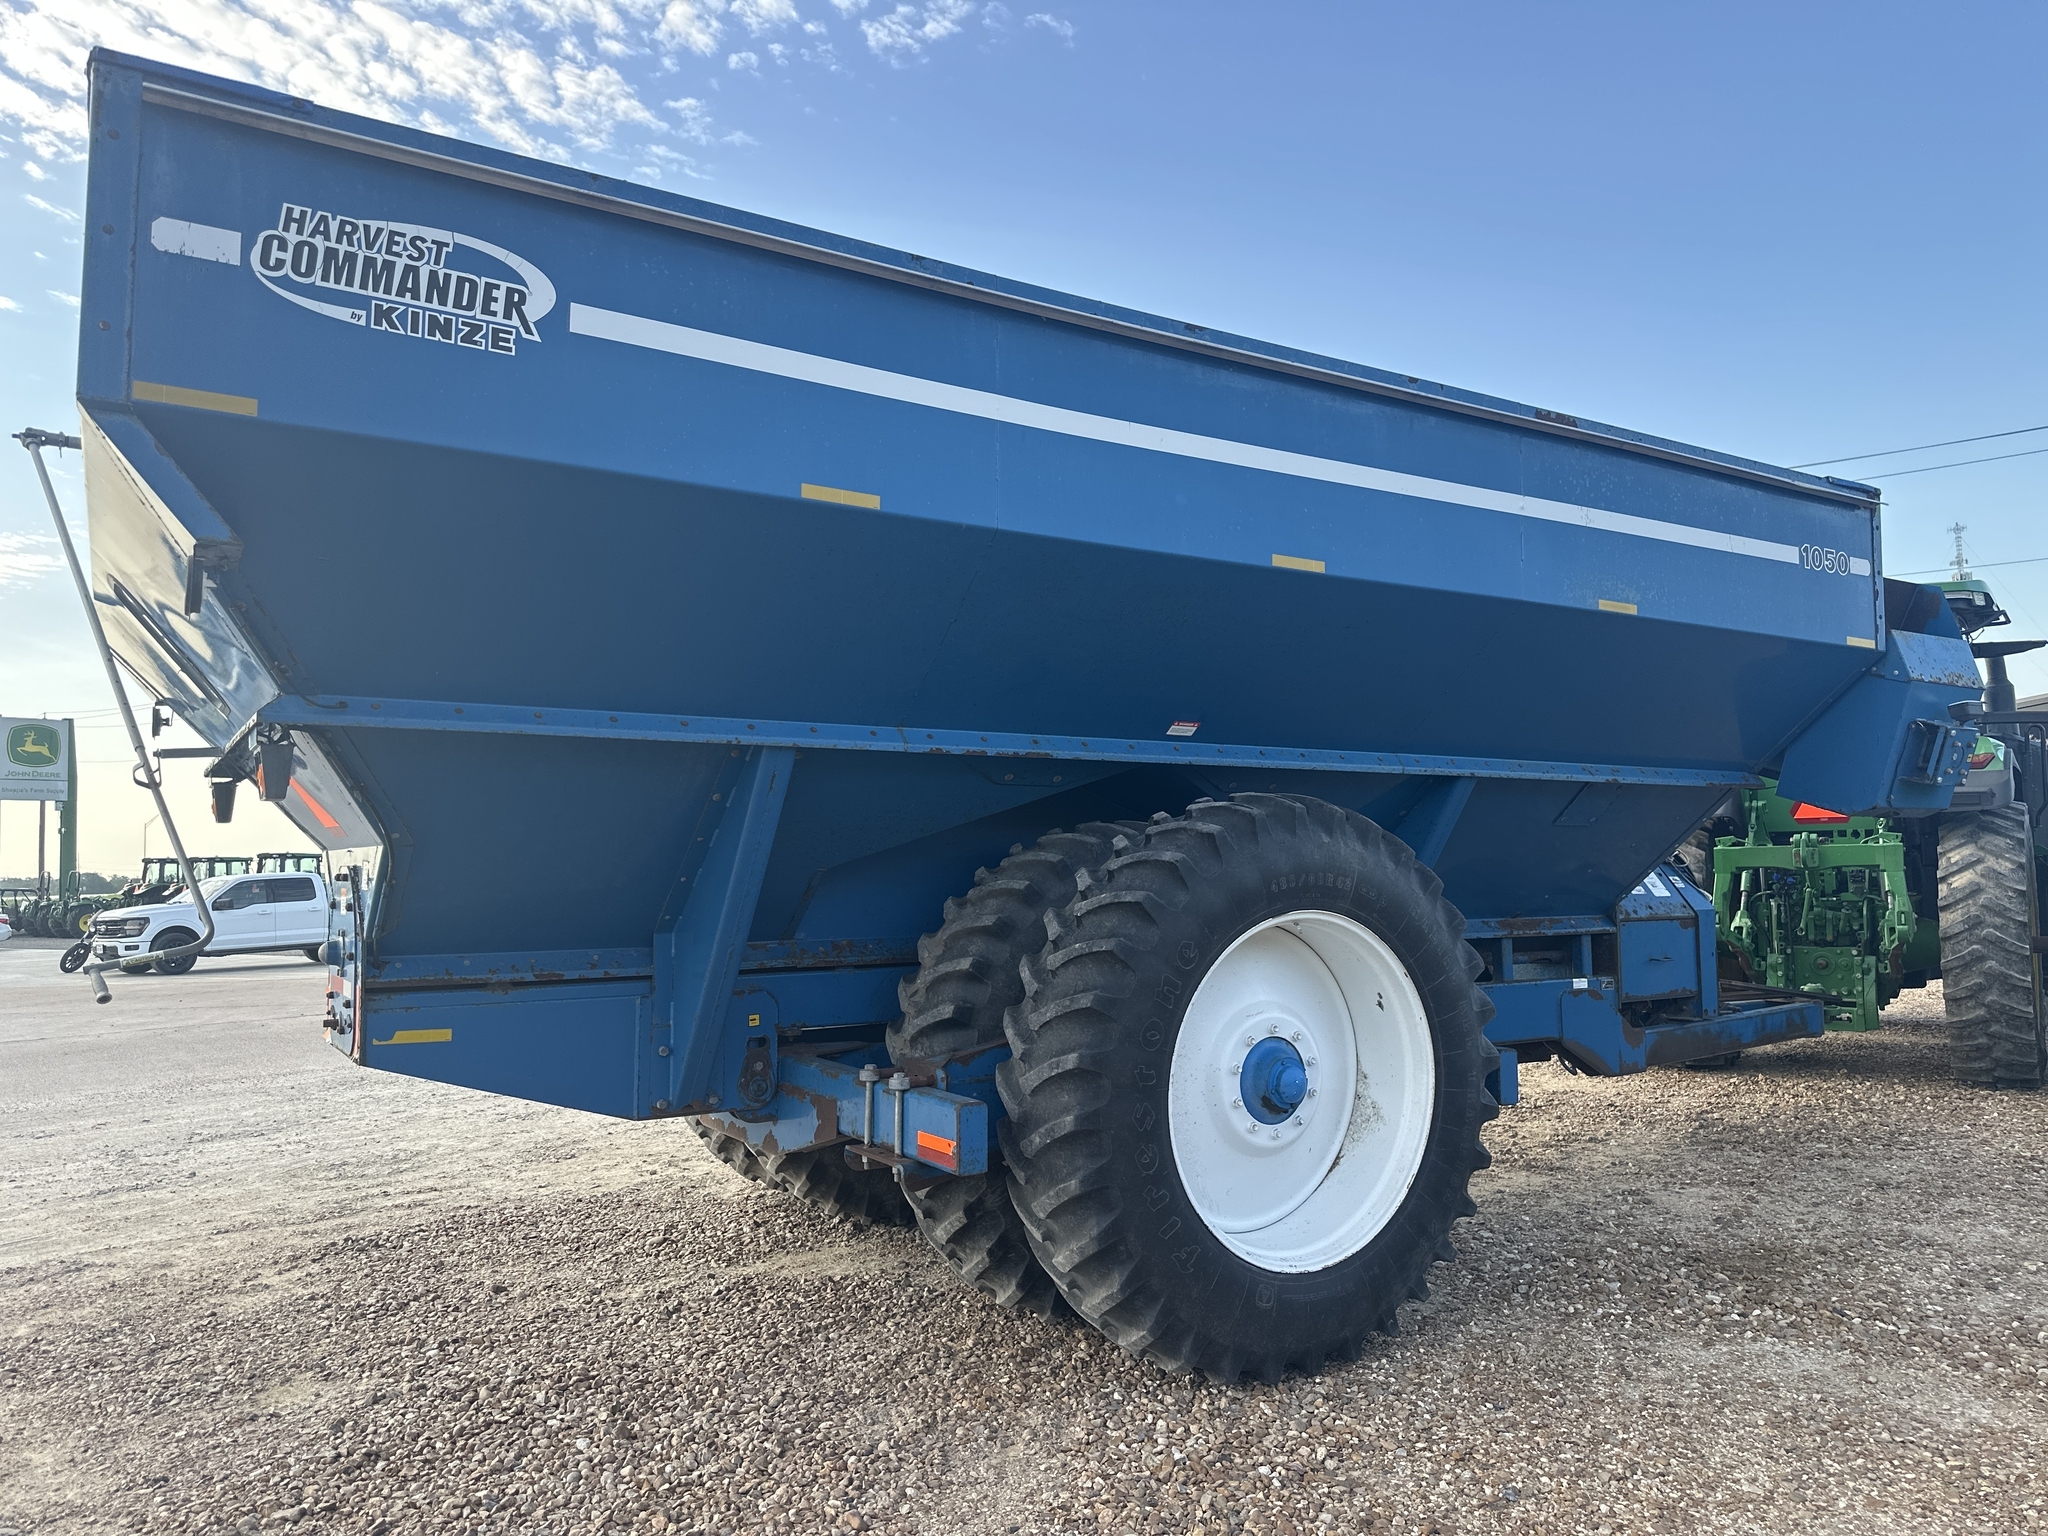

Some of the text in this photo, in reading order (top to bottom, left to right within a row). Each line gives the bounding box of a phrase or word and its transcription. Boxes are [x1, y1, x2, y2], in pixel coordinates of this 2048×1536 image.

[280, 204, 453, 267] HARVEST
[257, 232, 538, 340] COMMANDER
[350, 300, 516, 356] by KINZE
[1801, 543, 1850, 576] 1050
[5, 770, 61, 778] JOHN DEERE
[1131, 940, 1201, 1274] Firestone
